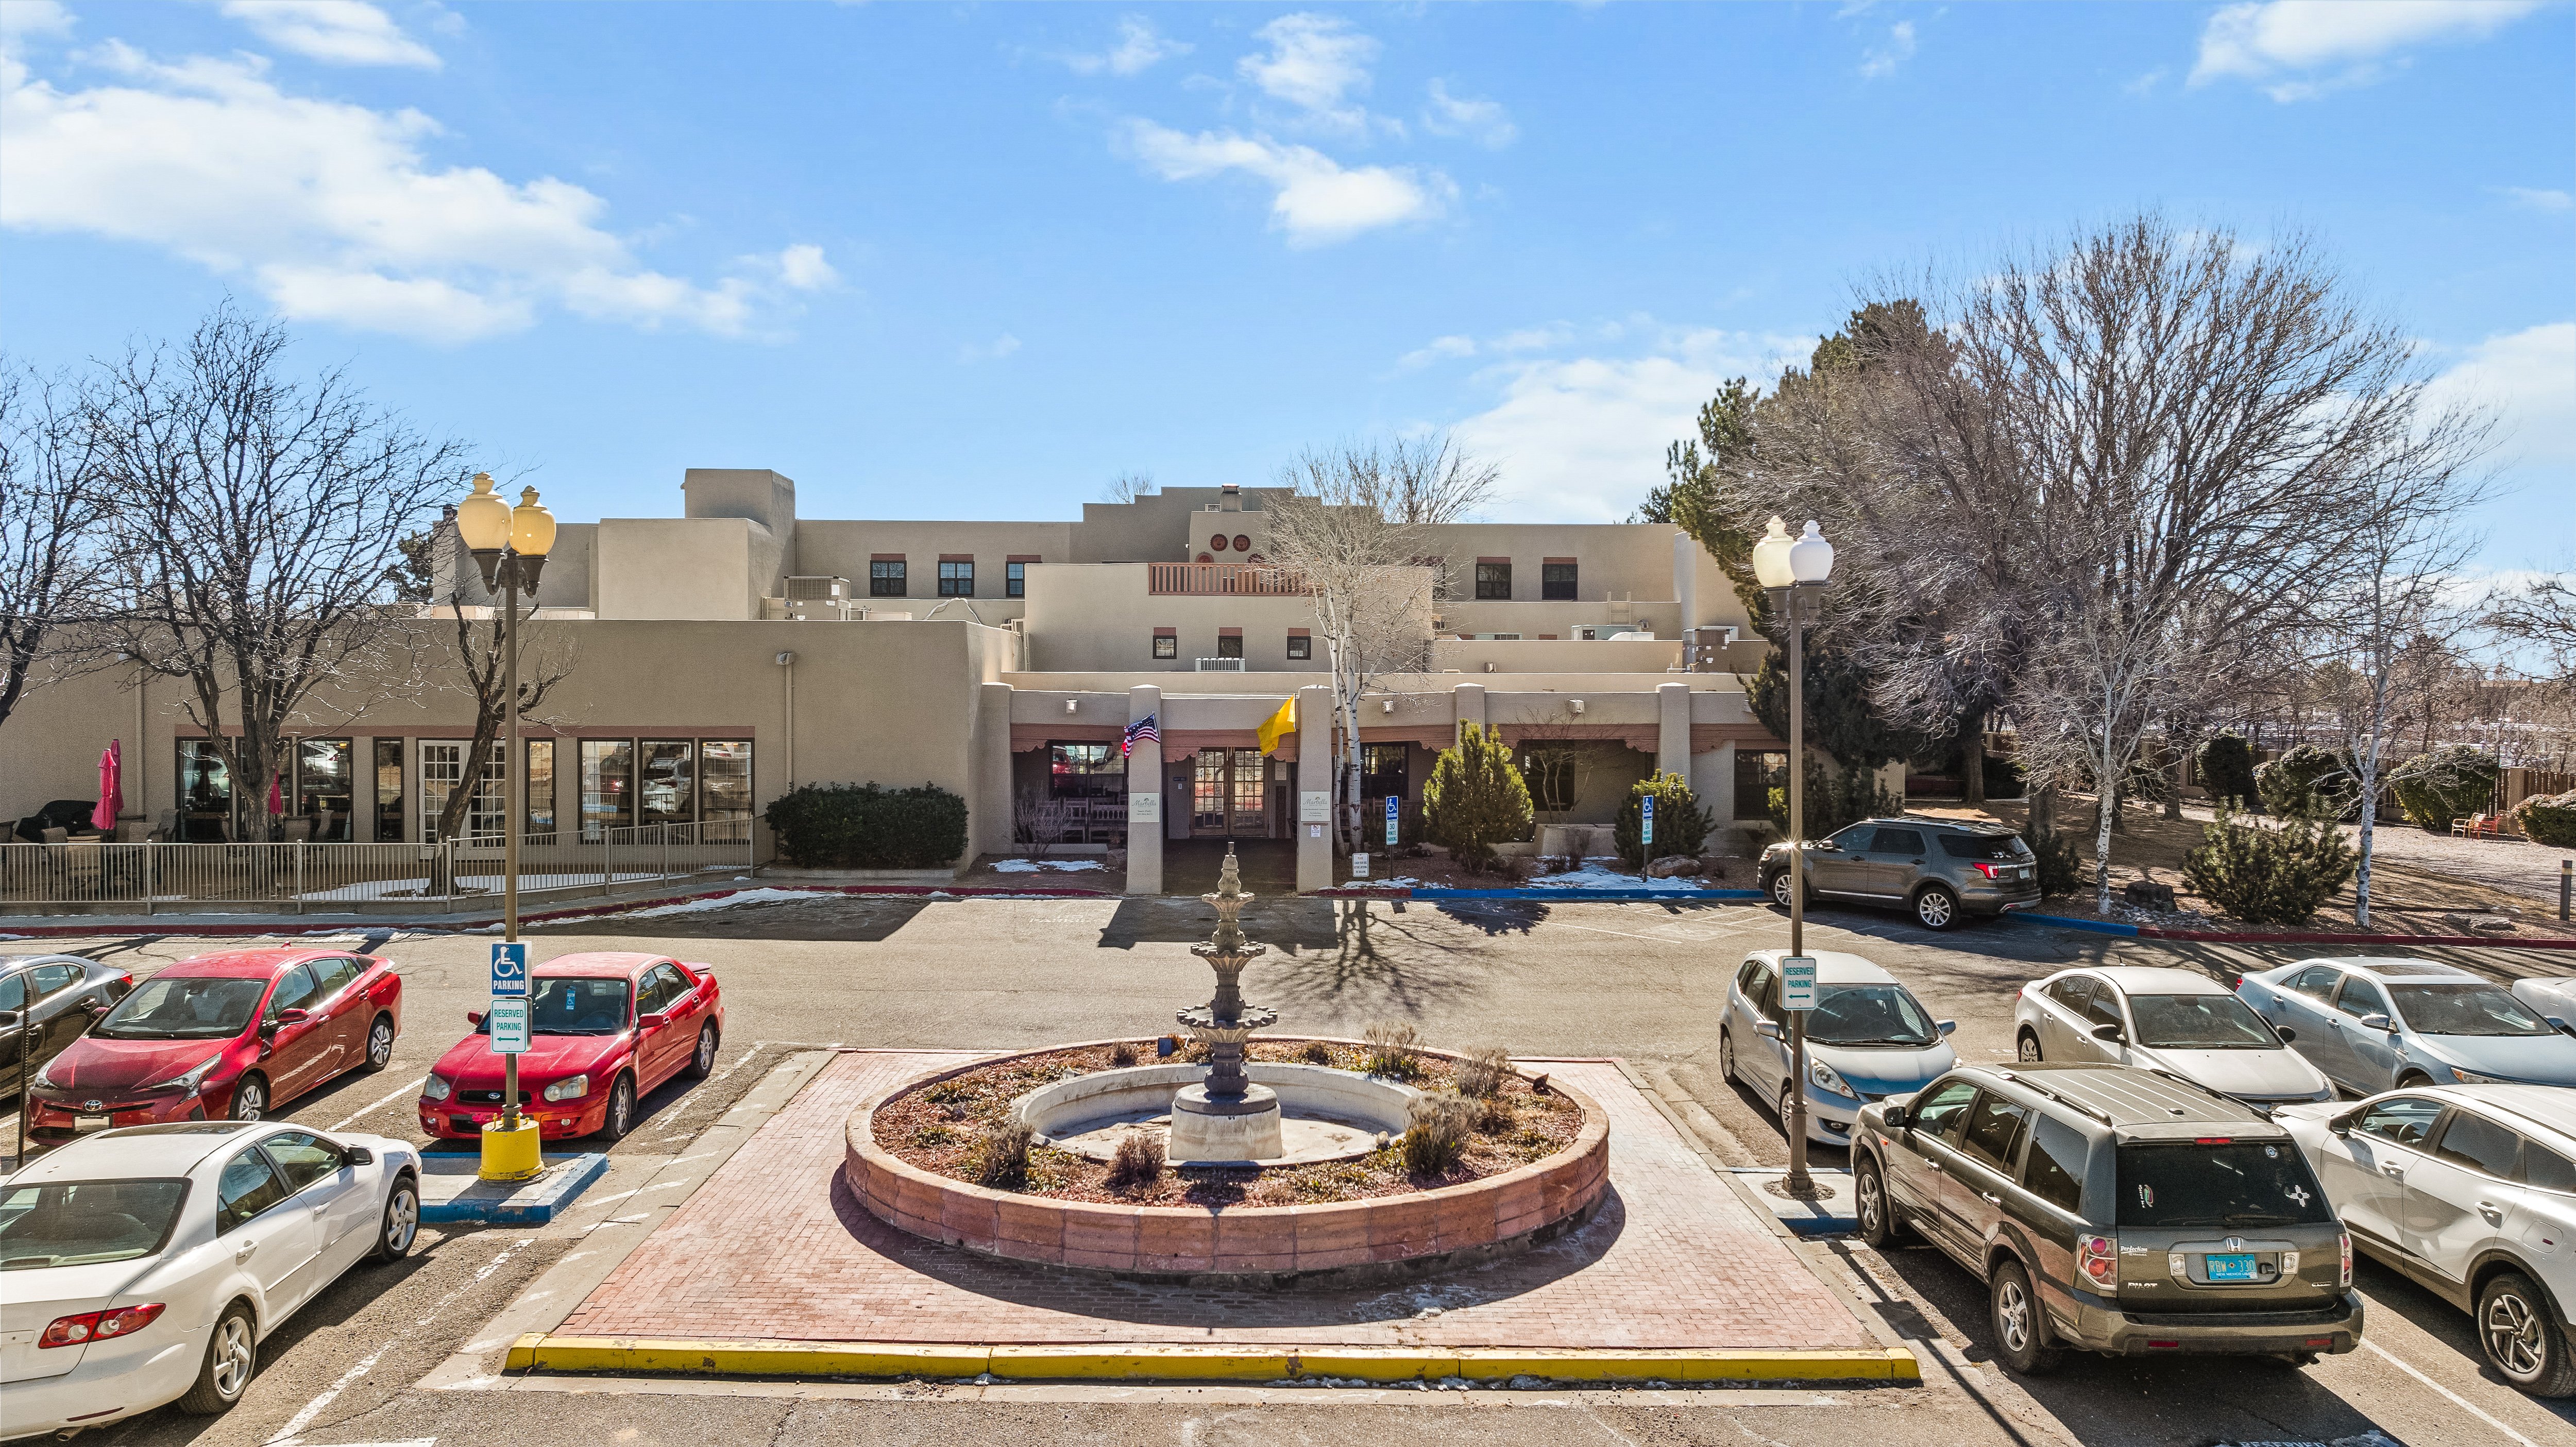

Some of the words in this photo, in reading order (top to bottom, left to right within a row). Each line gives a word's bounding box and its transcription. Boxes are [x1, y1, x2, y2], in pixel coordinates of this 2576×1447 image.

[1785, 967, 1814, 975] RESERVED
[493, 980, 524, 990] PARKING
[1788, 980, 1812, 988] PARKING
[494, 1009, 524, 1018] RESERVED
[496, 1022, 521, 1031] PARKING
[2238, 1259, 2255, 1272] 330
